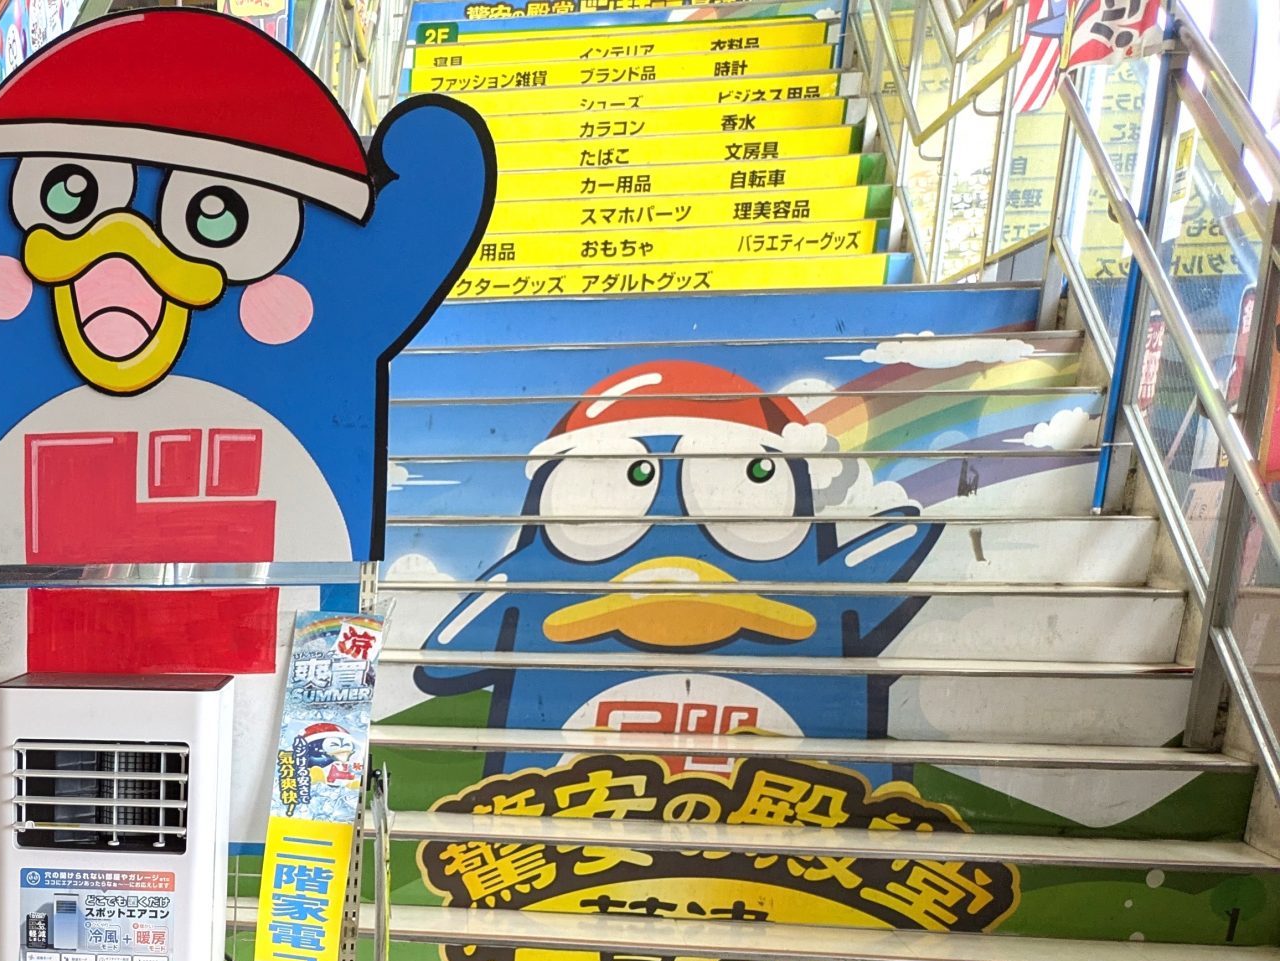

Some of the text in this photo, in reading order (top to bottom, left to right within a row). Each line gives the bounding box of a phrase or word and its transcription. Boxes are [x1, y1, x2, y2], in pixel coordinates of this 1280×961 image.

[424, 28, 449, 44] 2F
[430, 60, 748, 90] ファッション雑貨 ブランド品 時計
[580, 95, 644, 110] シューズ
[580, 113, 756, 138] カラコン 香水
[579, 141, 779, 167] たばこ 文房具
[580, 169, 786, 194] カー用品 自転車
[581, 200, 810, 225] スマホパーツ 理美容品
[581, 239, 655, 259] おもちゃ
[737, 231, 862, 253] バラエティーグッズ
[581, 271, 713, 294] アダルトグッズ
[289, 688, 372, 703] SUMMER
[85, 894, 171, 908] どこでも置くだけ
[85, 907, 170, 920] スポットエアコン
[89, 929, 166, 945] 冷風 暖房
